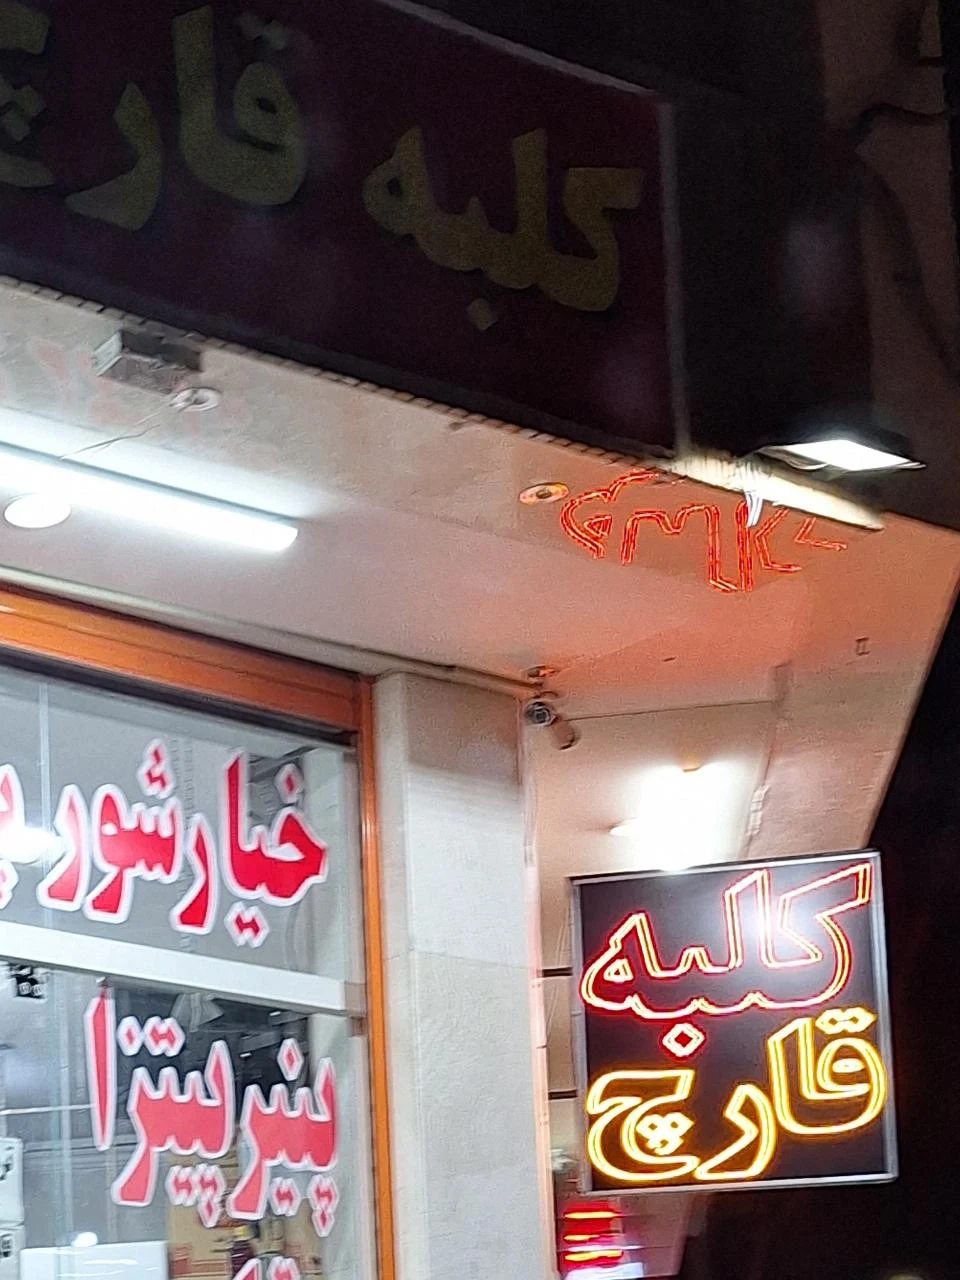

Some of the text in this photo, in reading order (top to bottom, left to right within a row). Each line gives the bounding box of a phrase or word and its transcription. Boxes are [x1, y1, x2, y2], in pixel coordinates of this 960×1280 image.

[364, 126, 639, 331] کلبه
[581, 862, 873, 1058] کلبه
[85, 980, 338, 1236] پنیر پیتزا
[587, 1008, 887, 1181] قارچ
